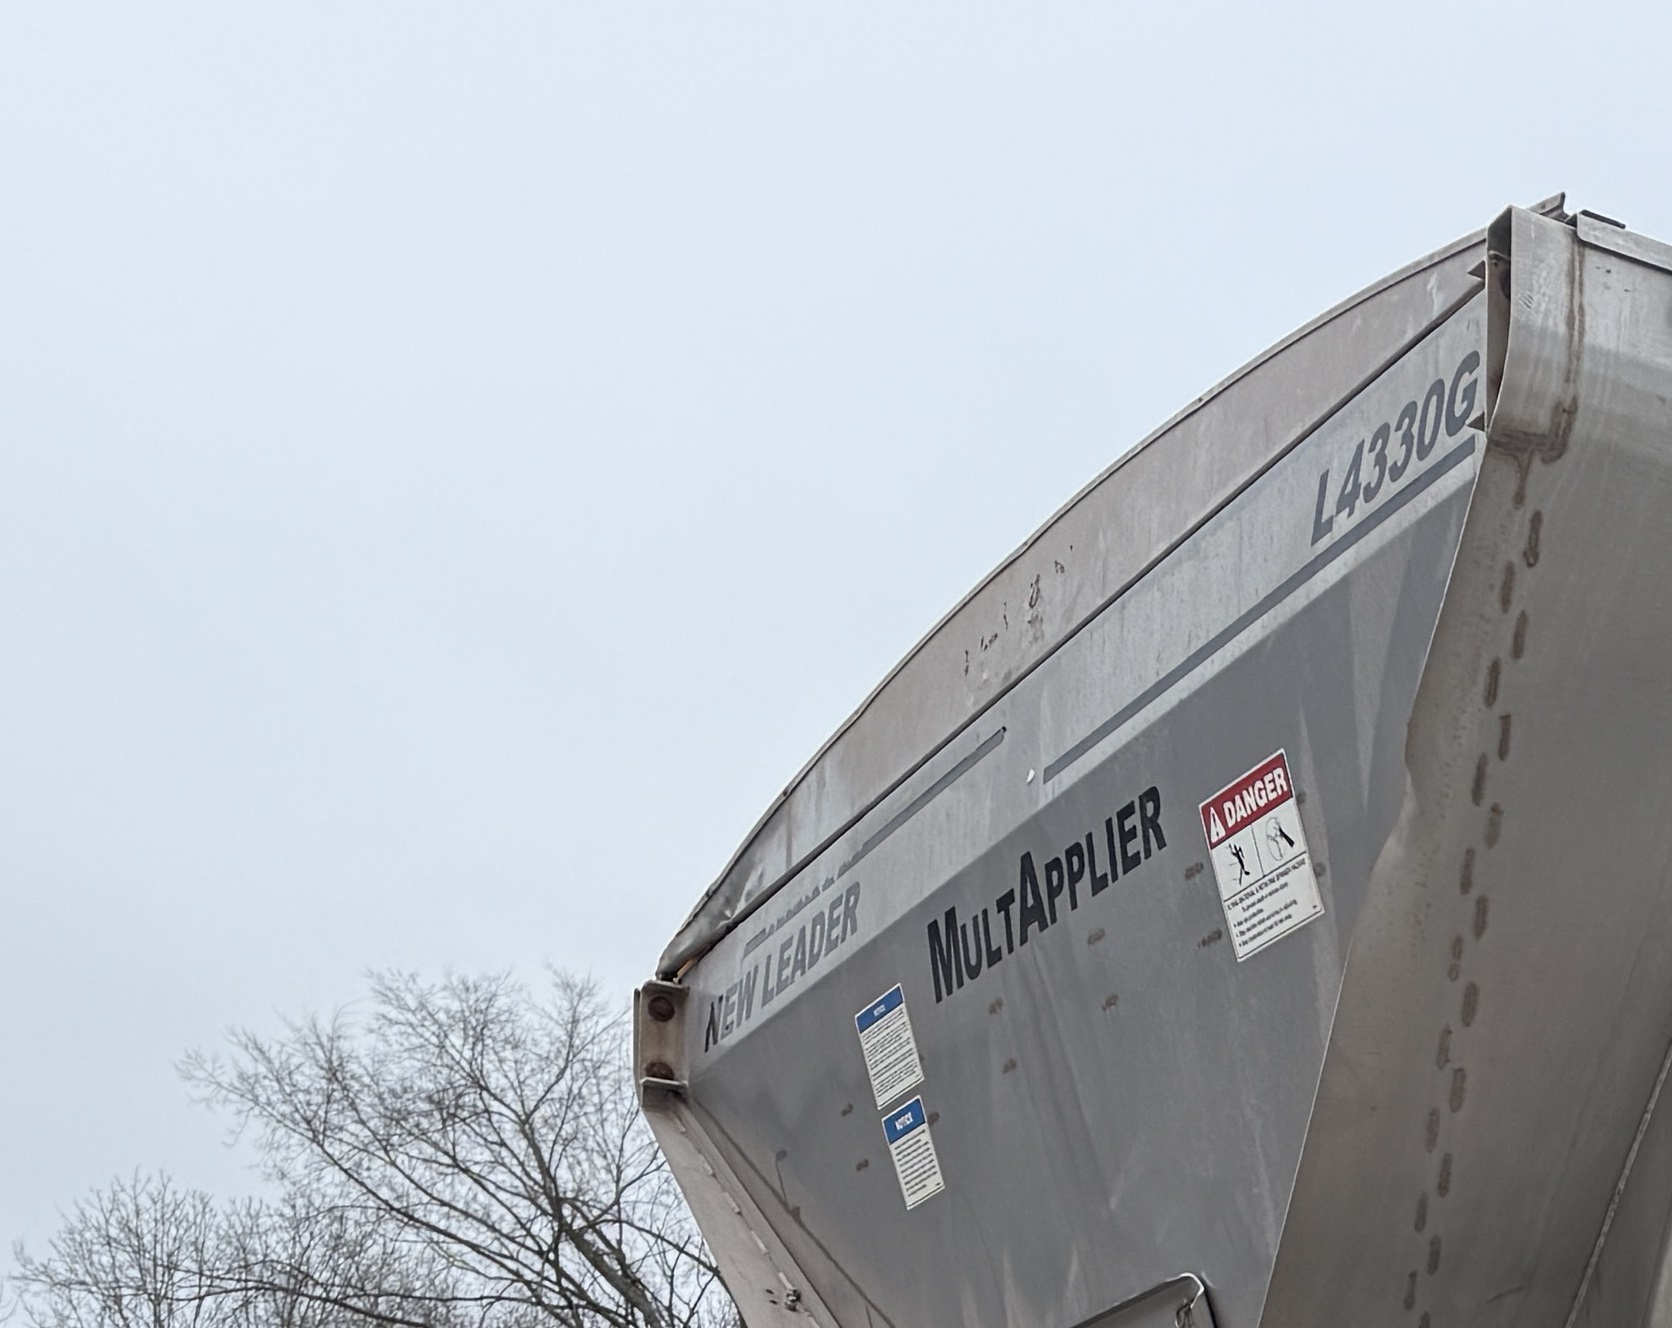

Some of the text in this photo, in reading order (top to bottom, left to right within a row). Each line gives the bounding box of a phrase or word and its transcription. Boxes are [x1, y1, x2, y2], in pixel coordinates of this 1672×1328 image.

[1311, 350, 1480, 547] L4330G
[1222, 767, 1288, 828] DANGER
[705, 881, 861, 1053] NEW LEADER
